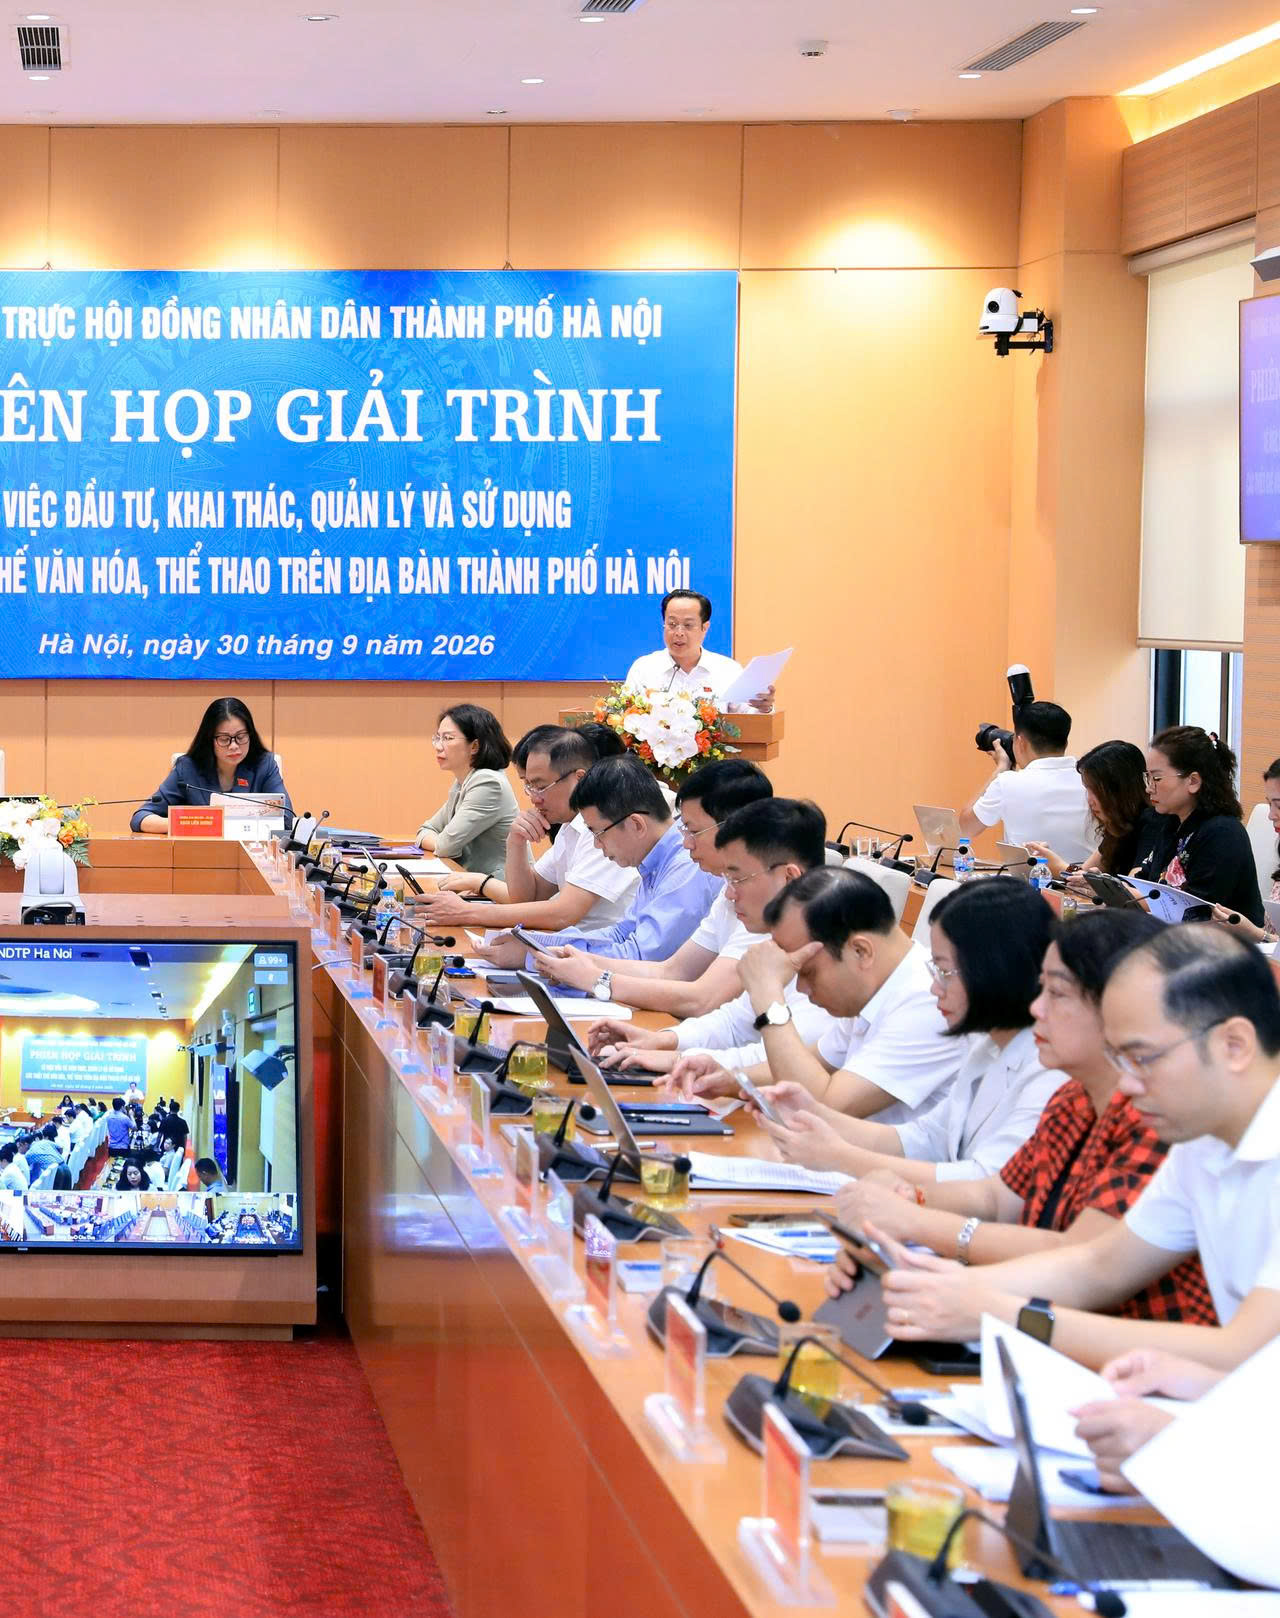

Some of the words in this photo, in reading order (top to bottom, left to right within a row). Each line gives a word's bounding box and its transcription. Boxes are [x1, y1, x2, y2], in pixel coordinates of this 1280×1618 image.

[2, 303, 76, 347] TRỰC
[84, 299, 132, 347] HỘI
[141, 295, 221, 340] ĐỒNG
[229, 295, 312, 340] NHÂN
[321, 299, 380, 339] DÂN
[390, 298, 485, 339] THÀNH
[495, 294, 554, 339] PHỐ
[563, 298, 602, 339] HÀ
[611, 297, 662, 345] NỘI
[110, 388, 252, 459] HỌP
[276, 369, 423, 443] GIẢI
[447, 369, 662, 443] TRÌNH
[3, 482, 58, 536] VIỆC
[65, 478, 115, 528] ĐẦU
[122, 488, 159, 533] TƯ,
[168, 490, 224, 529] KHAI
[232, 483, 303, 533] THÁC,
[311, 478, 379, 533] QUẢN
[387, 483, 416, 529] LÝ
[423, 482, 455, 529] VÀ
[462, 478, 498, 529] SỬ
[503, 490, 571, 537] DỤNG
[35, 549, 84, 594] VĂN
[92, 549, 149, 598] HÓA,
[156, 542, 202, 594] THỂ
[208, 556, 271, 594] THAO
[278, 549, 342, 594] TRÊN
[349, 556, 391, 603] ĐỊA
[399, 549, 450, 594] BÀN
[458, 548, 540, 595] THÀNH
[548, 544, 599, 595] PHỐ
[606, 549, 640, 595] HÀ
[38, 632, 74, 655] Hà
[83, 633, 133, 660] Nội,
[144, 633, 209, 661] ngày
[217, 634, 249, 655] 30
[257, 633, 334, 661] tháng
[343, 634, 358, 655] 9
[366, 634, 423, 655] năm
[432, 634, 496, 656] 2026
[34, 947, 51, 959] Ha
[54, 947, 73, 959] Noi
